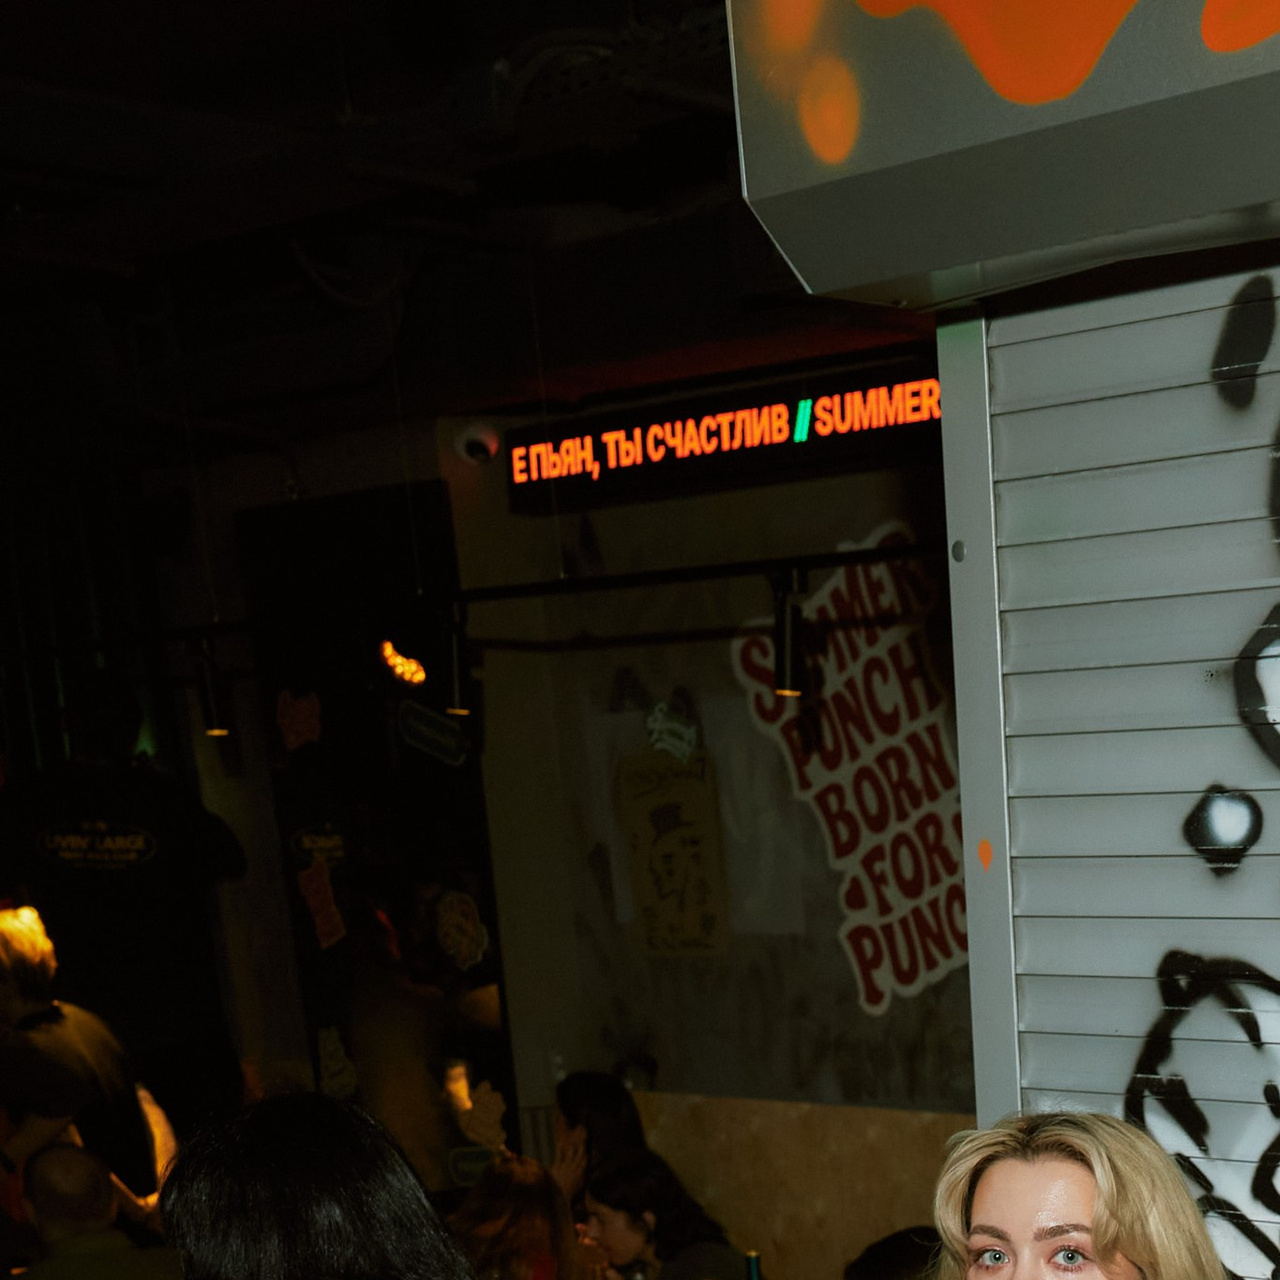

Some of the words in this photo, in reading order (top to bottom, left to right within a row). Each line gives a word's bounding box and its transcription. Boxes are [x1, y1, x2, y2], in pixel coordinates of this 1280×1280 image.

[529, 435, 600, 482] ПЬЯН,
[601, 427, 643, 470] ТЫ
[646, 403, 790, 463] СЧАСТЛИВ
[814, 378, 942, 437] SUMMER
[741, 531, 934, 724] SMER
[781, 633, 942, 790] PUNCH
[815, 724, 956, 860] BORN
[861, 813, 958, 916] FOR
